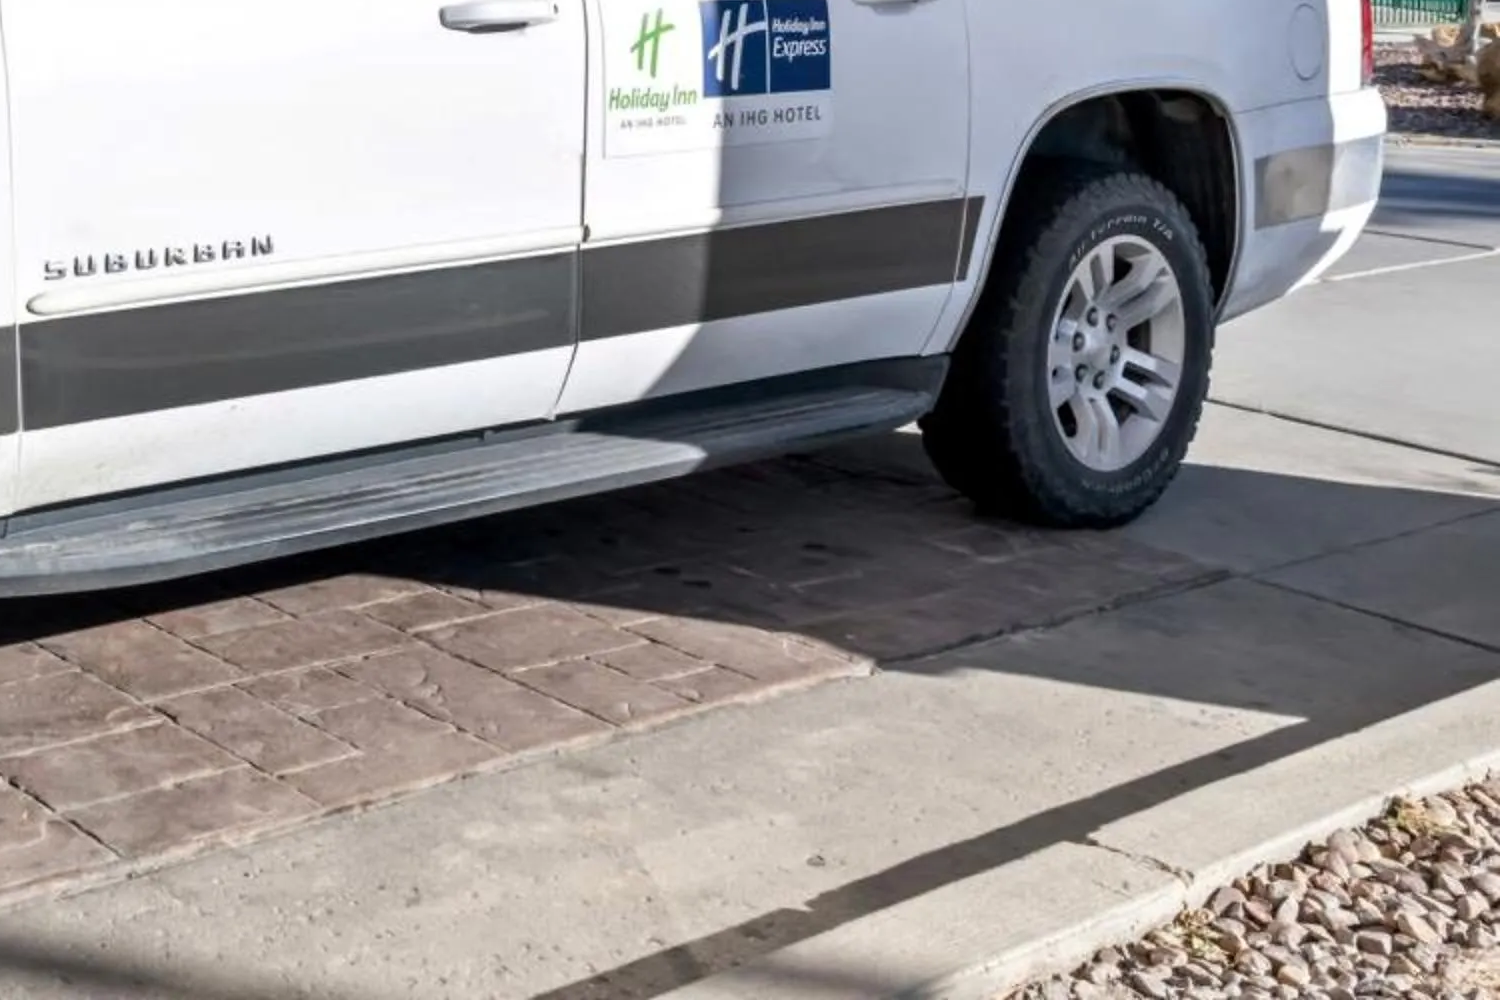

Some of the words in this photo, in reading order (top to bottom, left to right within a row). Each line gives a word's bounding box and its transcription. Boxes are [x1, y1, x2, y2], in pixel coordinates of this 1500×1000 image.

[772, 36, 828, 63] Express
[608, 86, 672, 113] Holiday
[671, 82, 698, 106] Inn
[711, 111, 735, 129] AN
[739, 109, 769, 126] IHG
[772, 105, 822, 124] HOTEL
[43, 234, 274, 281] SUBURBAN
